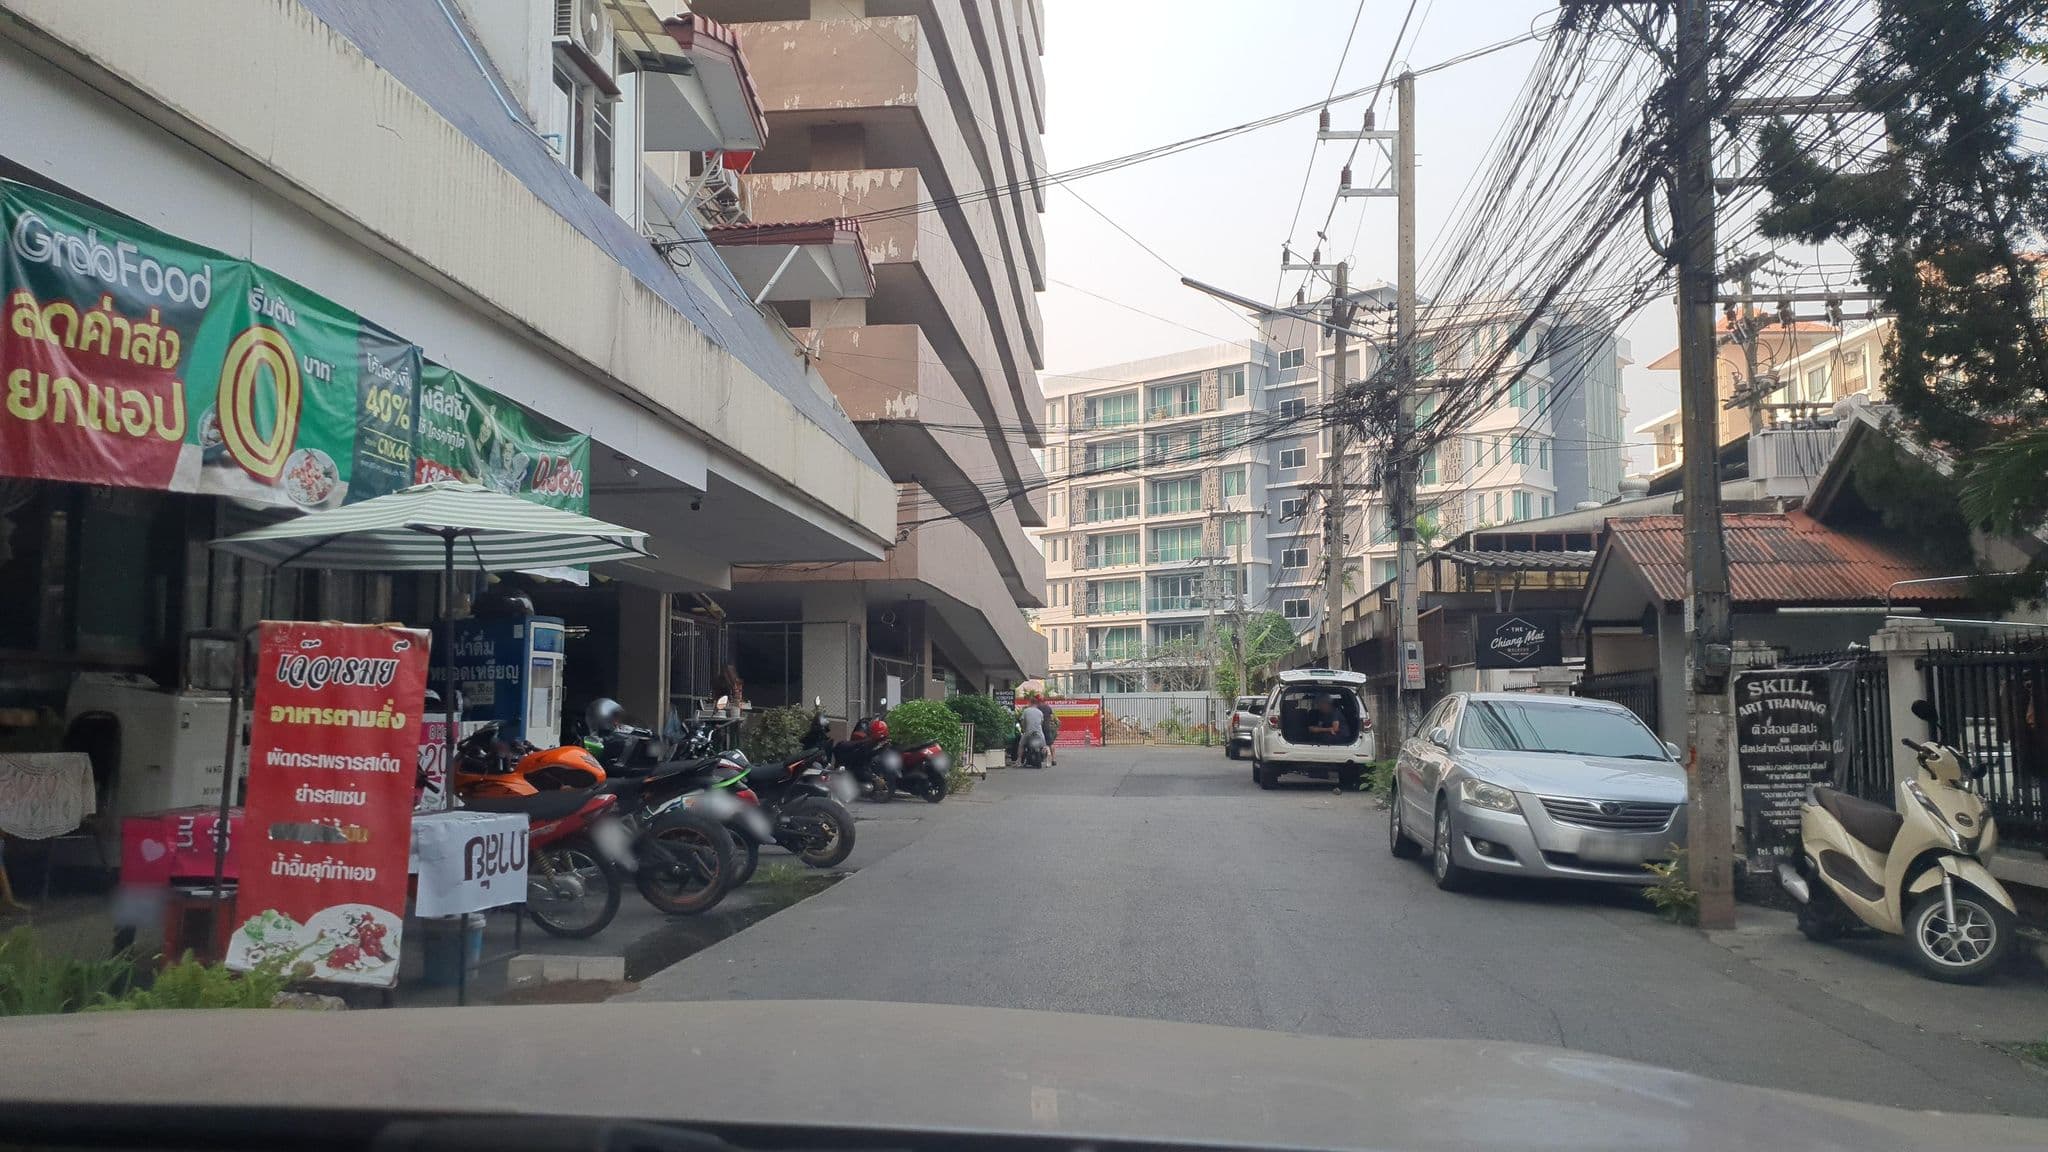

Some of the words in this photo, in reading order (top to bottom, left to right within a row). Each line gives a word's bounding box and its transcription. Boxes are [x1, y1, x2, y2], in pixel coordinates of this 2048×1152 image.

[13, 210, 212, 309] GrabFood
[11, 291, 180, 369] ลดค่าส่ง
[7, 368, 187, 442] ยกแอป
[216, 325, 301, 484] 0
[365, 385, 410, 430] 40%
[1490, 636, 1523, 649] Chiang
[1523, 629, 1545, 645] Mai
[1747, 678, 1814, 697] SKILL
[270, 698, 407, 730] อาหารตามสั่ง
[1739, 700, 1763, 717] ART
[1767, 697, 1827, 715] TRAINING
[267, 747, 400, 773] ผัดกระเพรารสเด็ด
[295, 783, 367, 806] ยำรสแซ่บ
[271, 852, 377, 883] น้ำจิ้มสุกี้ทำเอง
